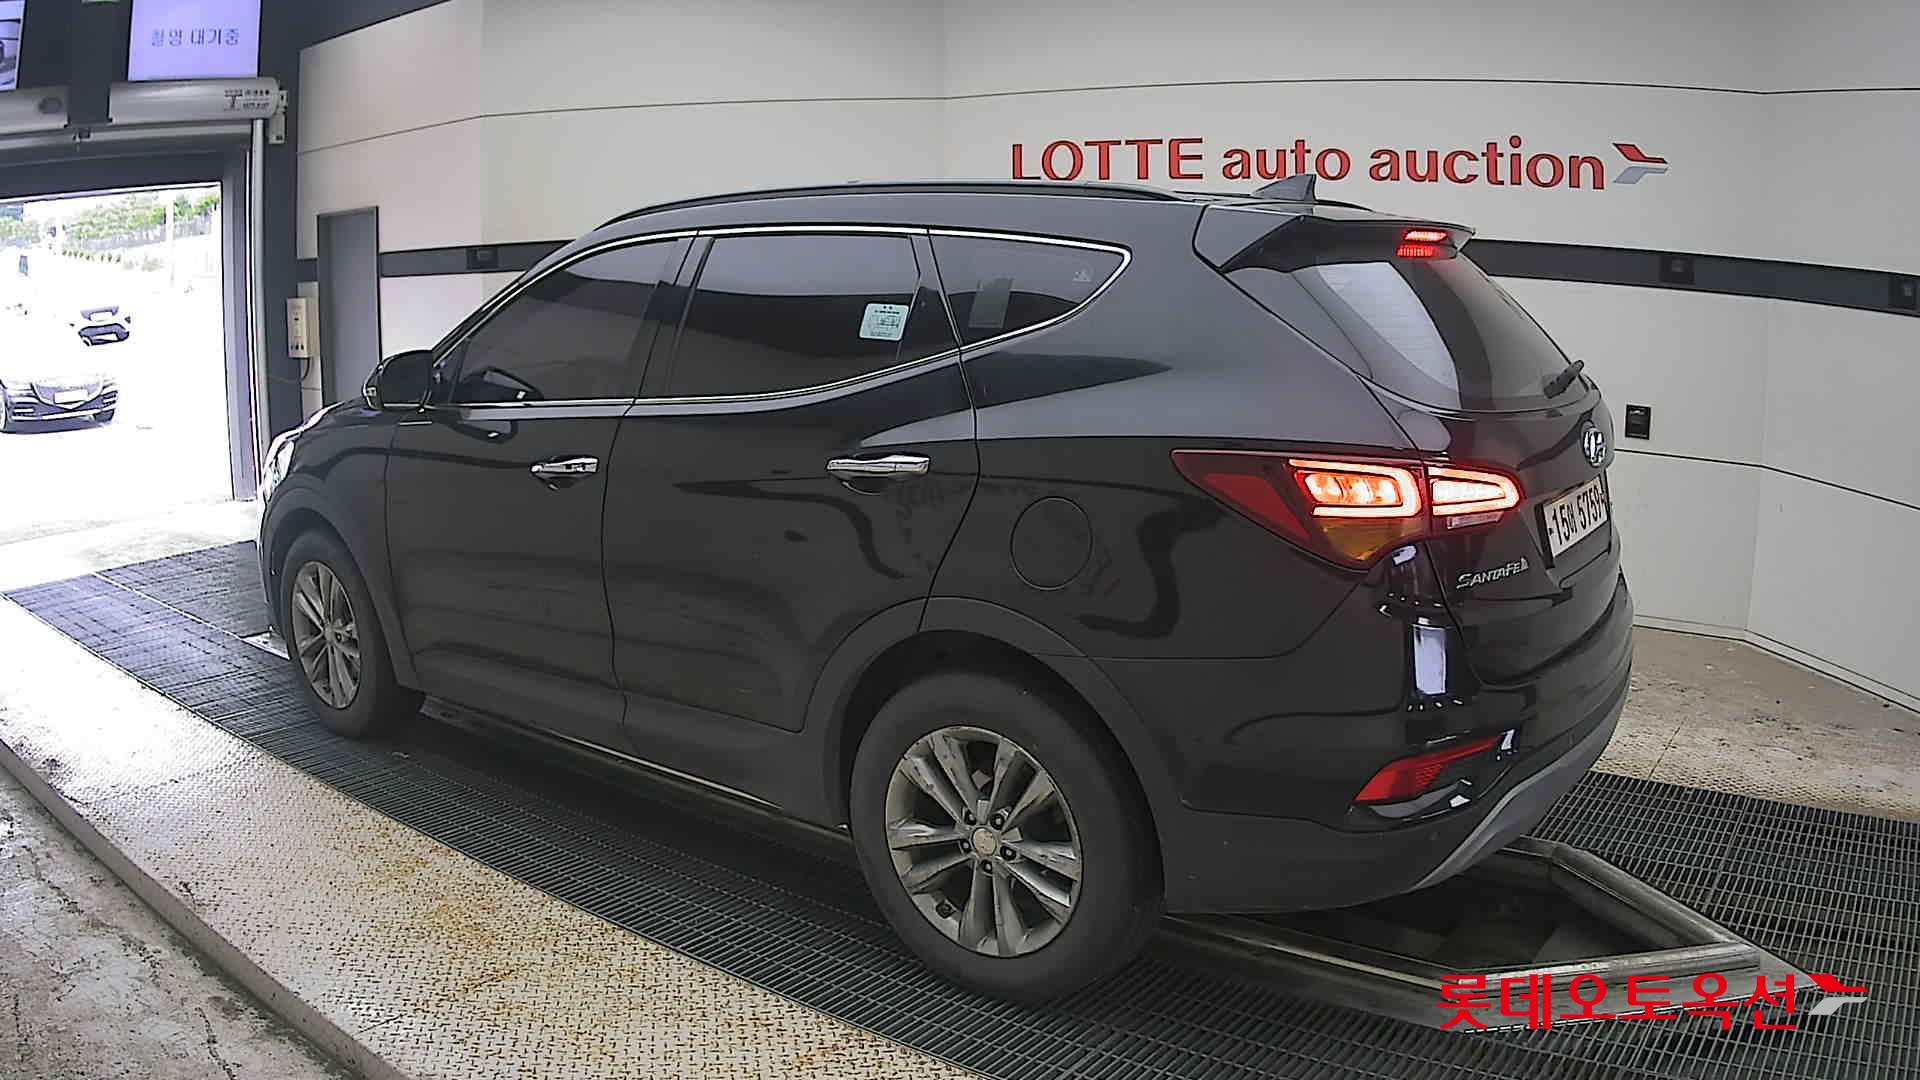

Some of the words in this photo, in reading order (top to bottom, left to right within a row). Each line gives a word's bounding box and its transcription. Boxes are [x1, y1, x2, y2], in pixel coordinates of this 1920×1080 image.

[191, 27, 240, 46] 대기중
[1012, 138, 1202, 182] LOTTE
[1222, 139, 1352, 182] auto
[1369, 135, 1606, 190] auction
[1577, 485, 1602, 530] 5759
